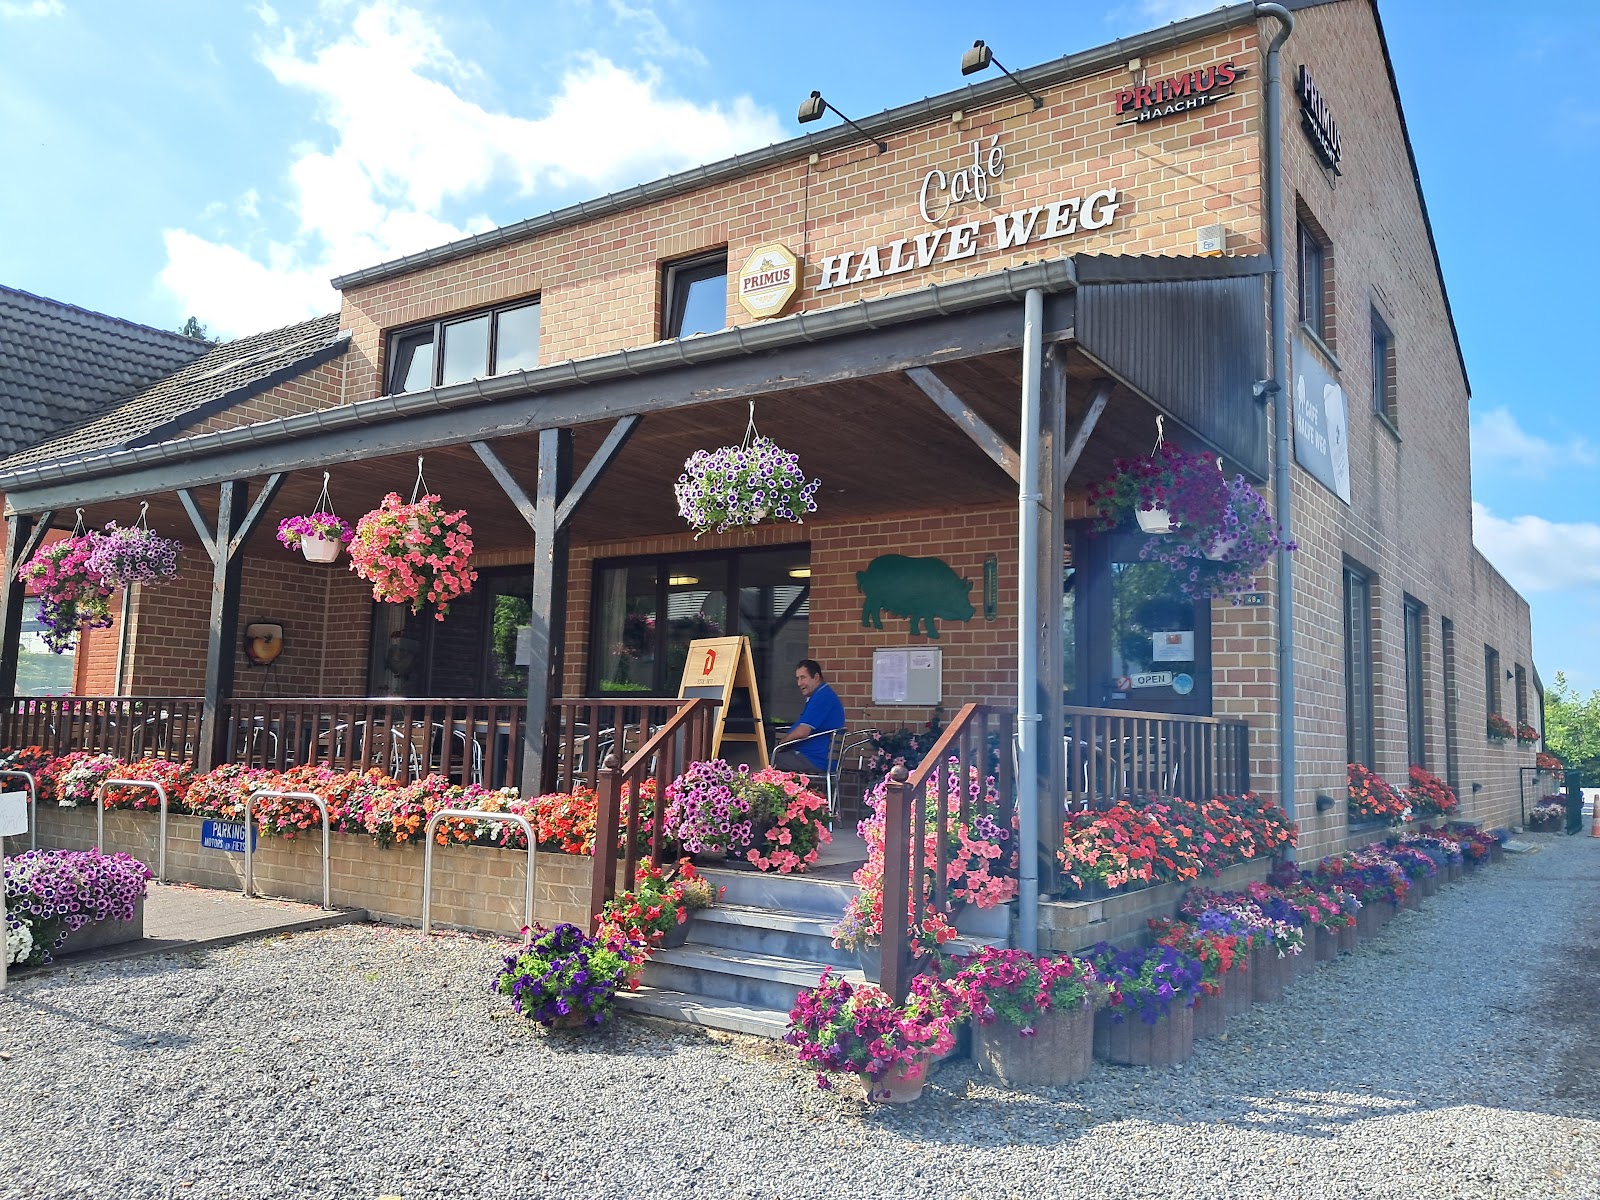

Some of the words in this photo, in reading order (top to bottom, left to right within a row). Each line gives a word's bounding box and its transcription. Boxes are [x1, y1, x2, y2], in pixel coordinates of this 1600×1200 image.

[1115, 62, 1236, 115] PRIMUS
[1140, 95, 1208, 121] HAACHT
[1303, 66, 1342, 161] PRIMUS
[919, 134, 1005, 223] Café
[815, 220, 980, 291] HALVE
[991, 187, 1120, 249] WEG
[743, 268, 791, 290] PRIMUS
[1137, 674, 1166, 684] OPEN
[204, 837, 224, 849] MOTORS
[212, 822, 246, 840] PARKING
